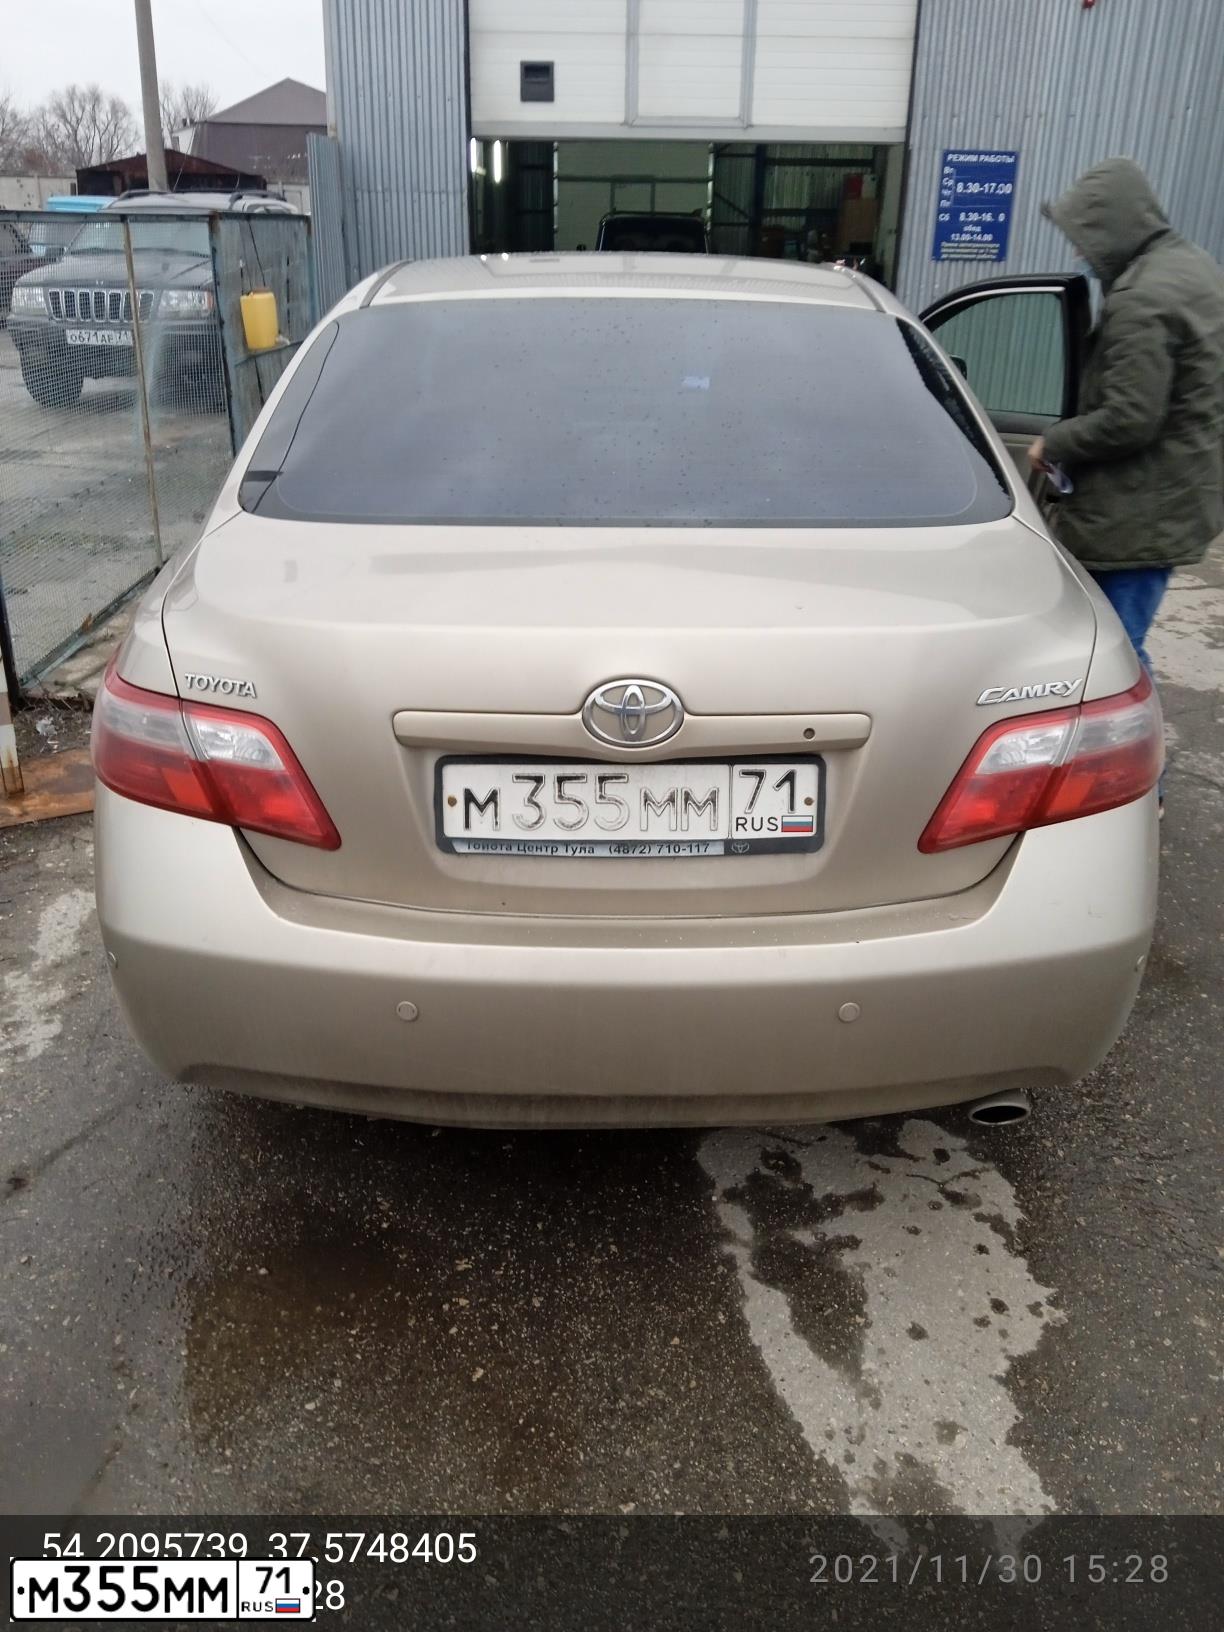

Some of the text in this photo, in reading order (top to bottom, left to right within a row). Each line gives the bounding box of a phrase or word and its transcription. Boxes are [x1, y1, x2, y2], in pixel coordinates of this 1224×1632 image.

[947, 154, 1015, 163] РЕЖИМ РАБОТЫ
[184, 673, 257, 699] TOYOTA
[976, 679, 1083, 706] CAMRY
[739, 769, 797, 814] 71
[736, 816, 778, 832] RUS
[517, 843, 558, 855] Центр
[657, 843, 711, 855] 710-117
